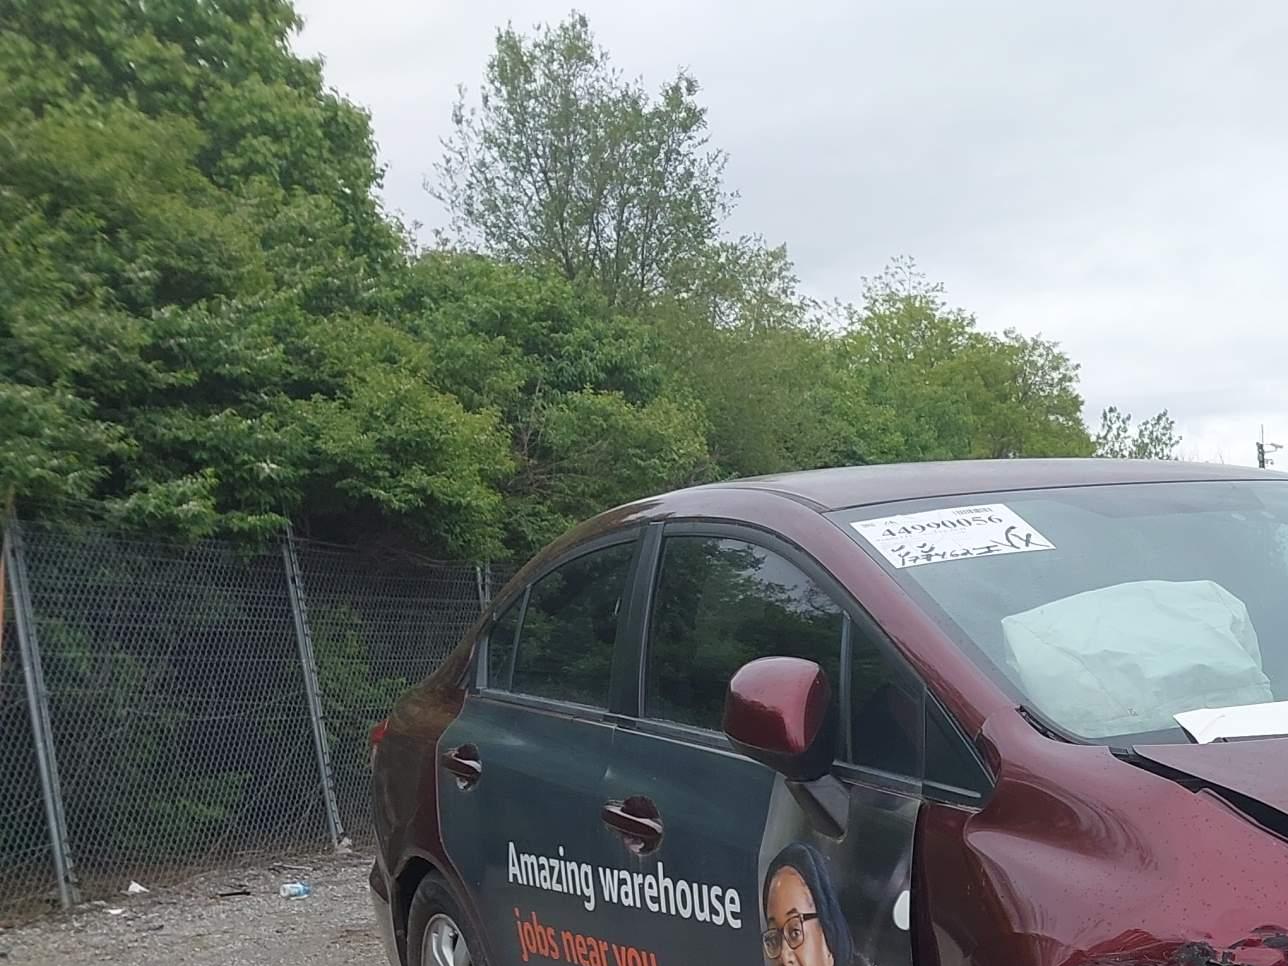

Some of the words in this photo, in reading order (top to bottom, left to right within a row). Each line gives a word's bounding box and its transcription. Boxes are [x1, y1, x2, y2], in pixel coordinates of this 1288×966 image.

[881, 515, 1004, 538] 44990056
[507, 841, 595, 912] Amazing
[598, 861, 742, 929] warehouse
[513, 906, 561, 962] jobs
